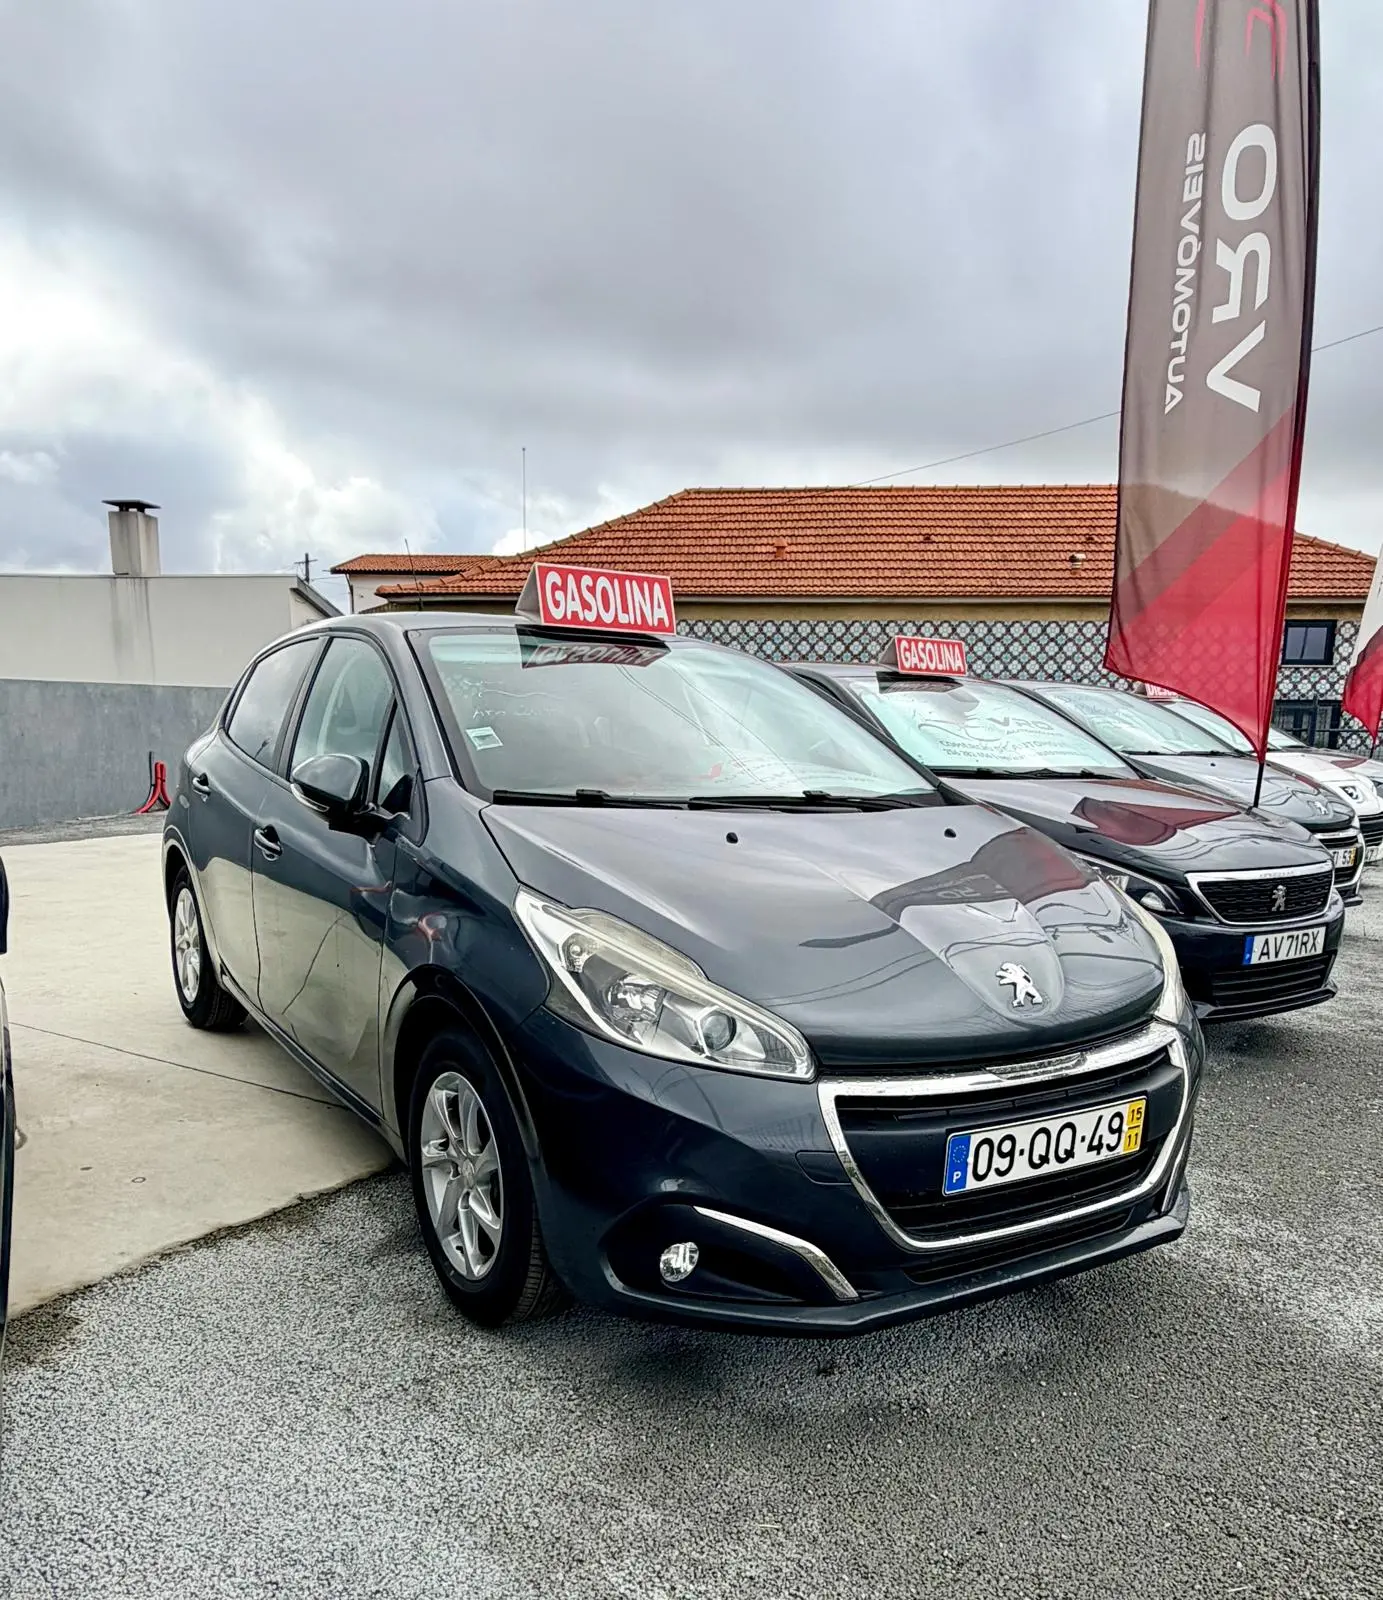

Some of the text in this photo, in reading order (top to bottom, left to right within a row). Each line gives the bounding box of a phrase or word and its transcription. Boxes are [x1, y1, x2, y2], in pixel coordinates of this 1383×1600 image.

[545, 571, 669, 628] GASOLINA
[900, 640, 965, 672] GASOLINA
[1258, 930, 1320, 961] AV71RX
[1128, 1107, 1142, 1122] 15
[1127, 1132, 1138, 1147] 11
[952, 1171, 962, 1184] P
